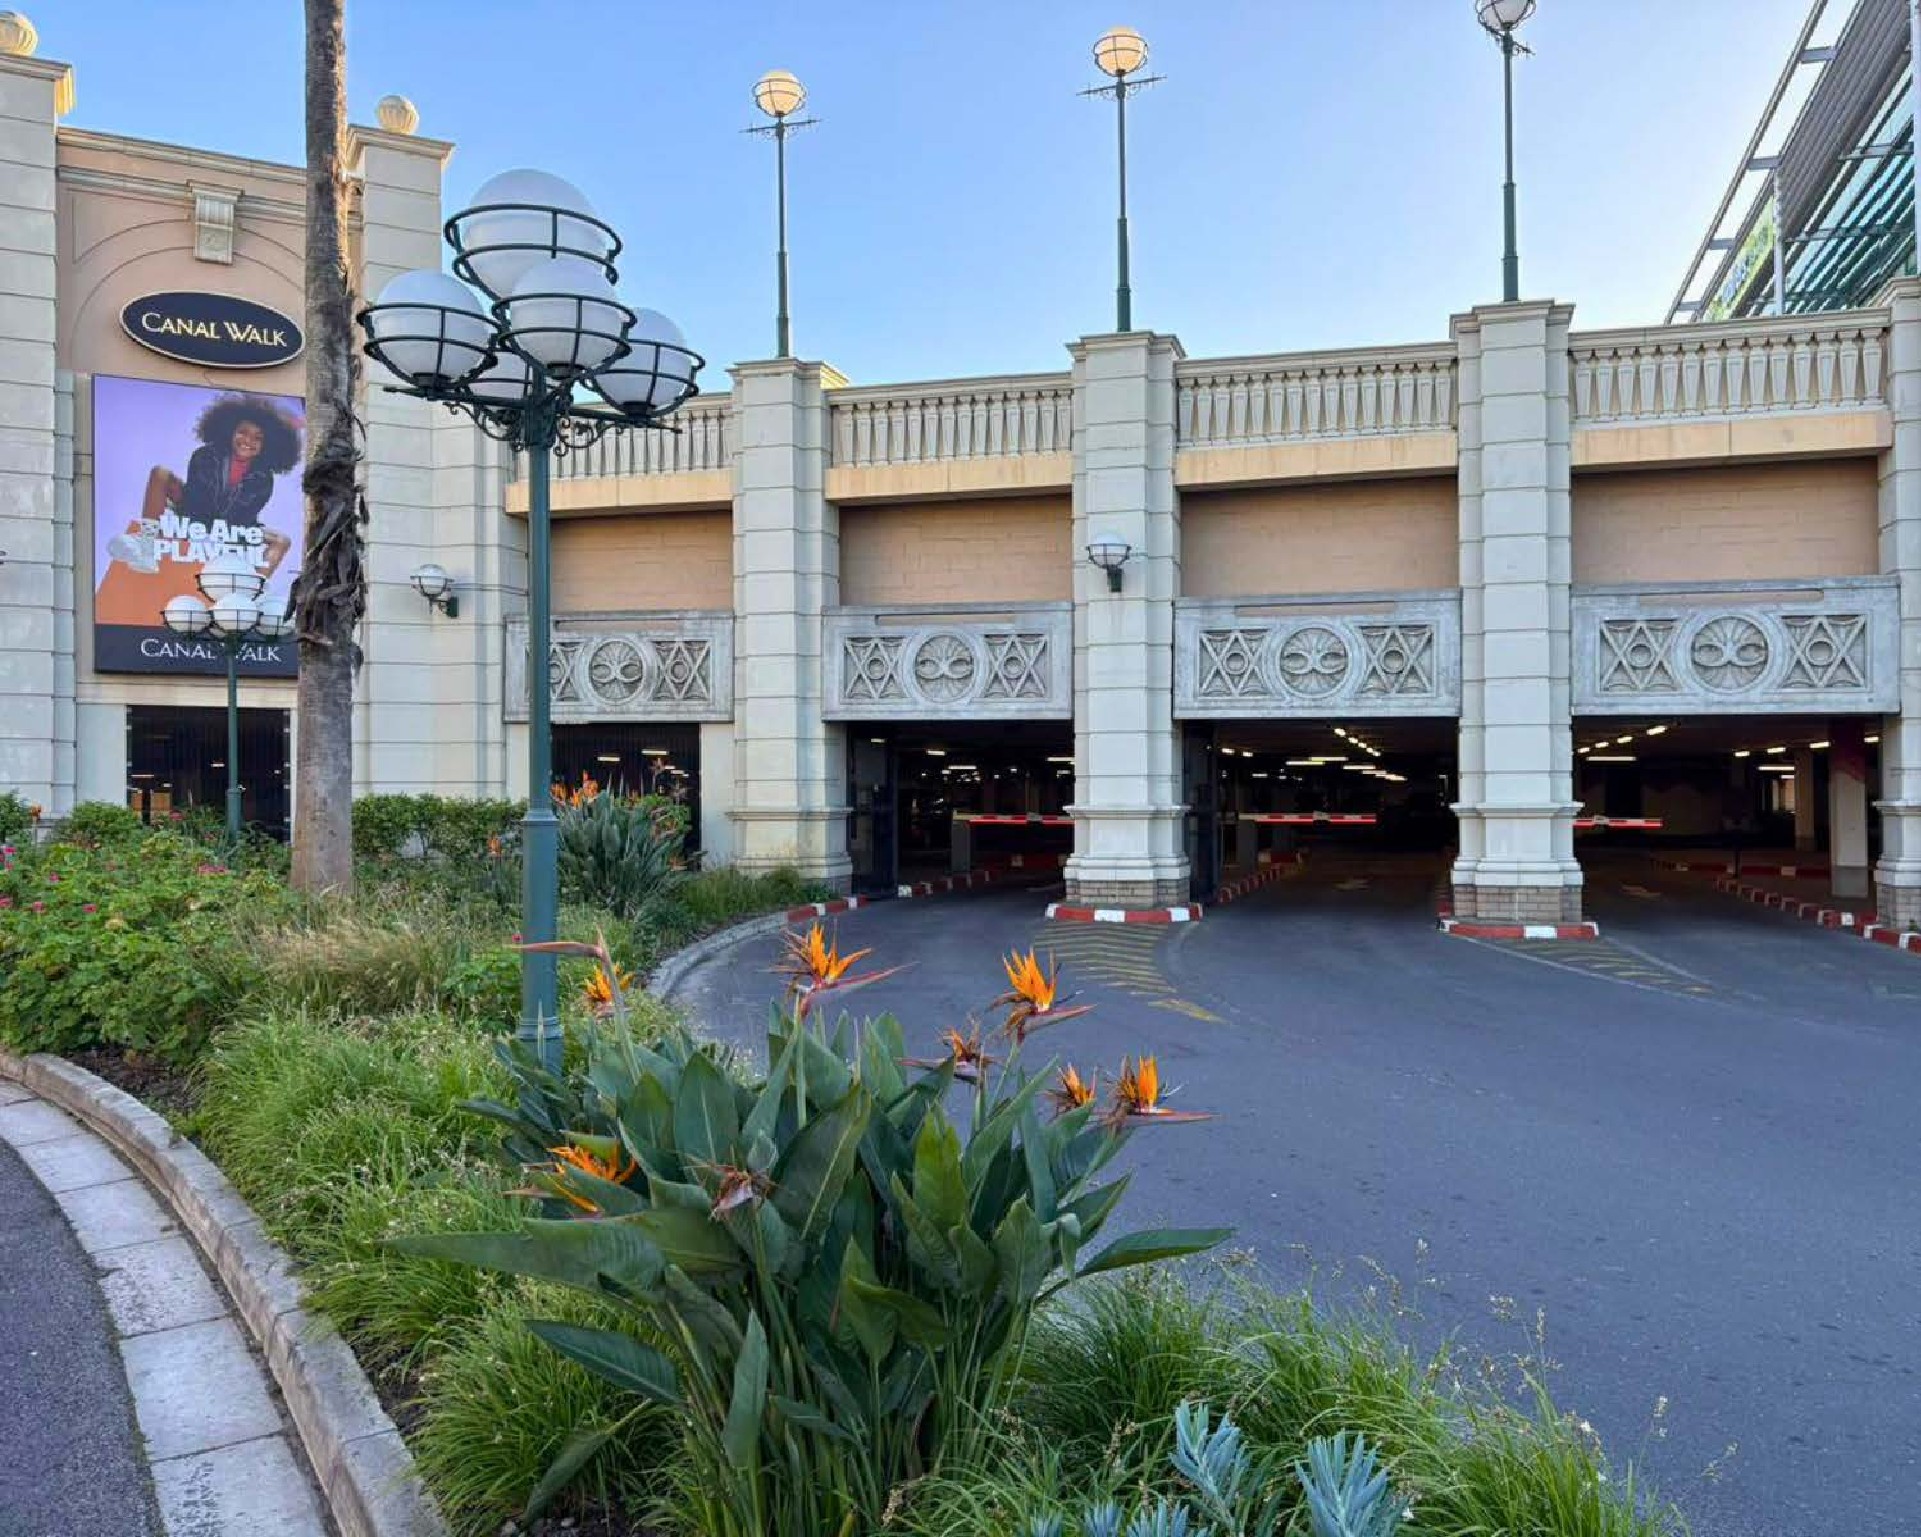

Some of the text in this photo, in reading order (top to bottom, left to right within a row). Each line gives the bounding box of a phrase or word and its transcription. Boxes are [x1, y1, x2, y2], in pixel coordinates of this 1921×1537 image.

[141, 312, 287, 348] CANAL WALK
[160, 513, 265, 545] We Are
[140, 638, 217, 660] CANAL
